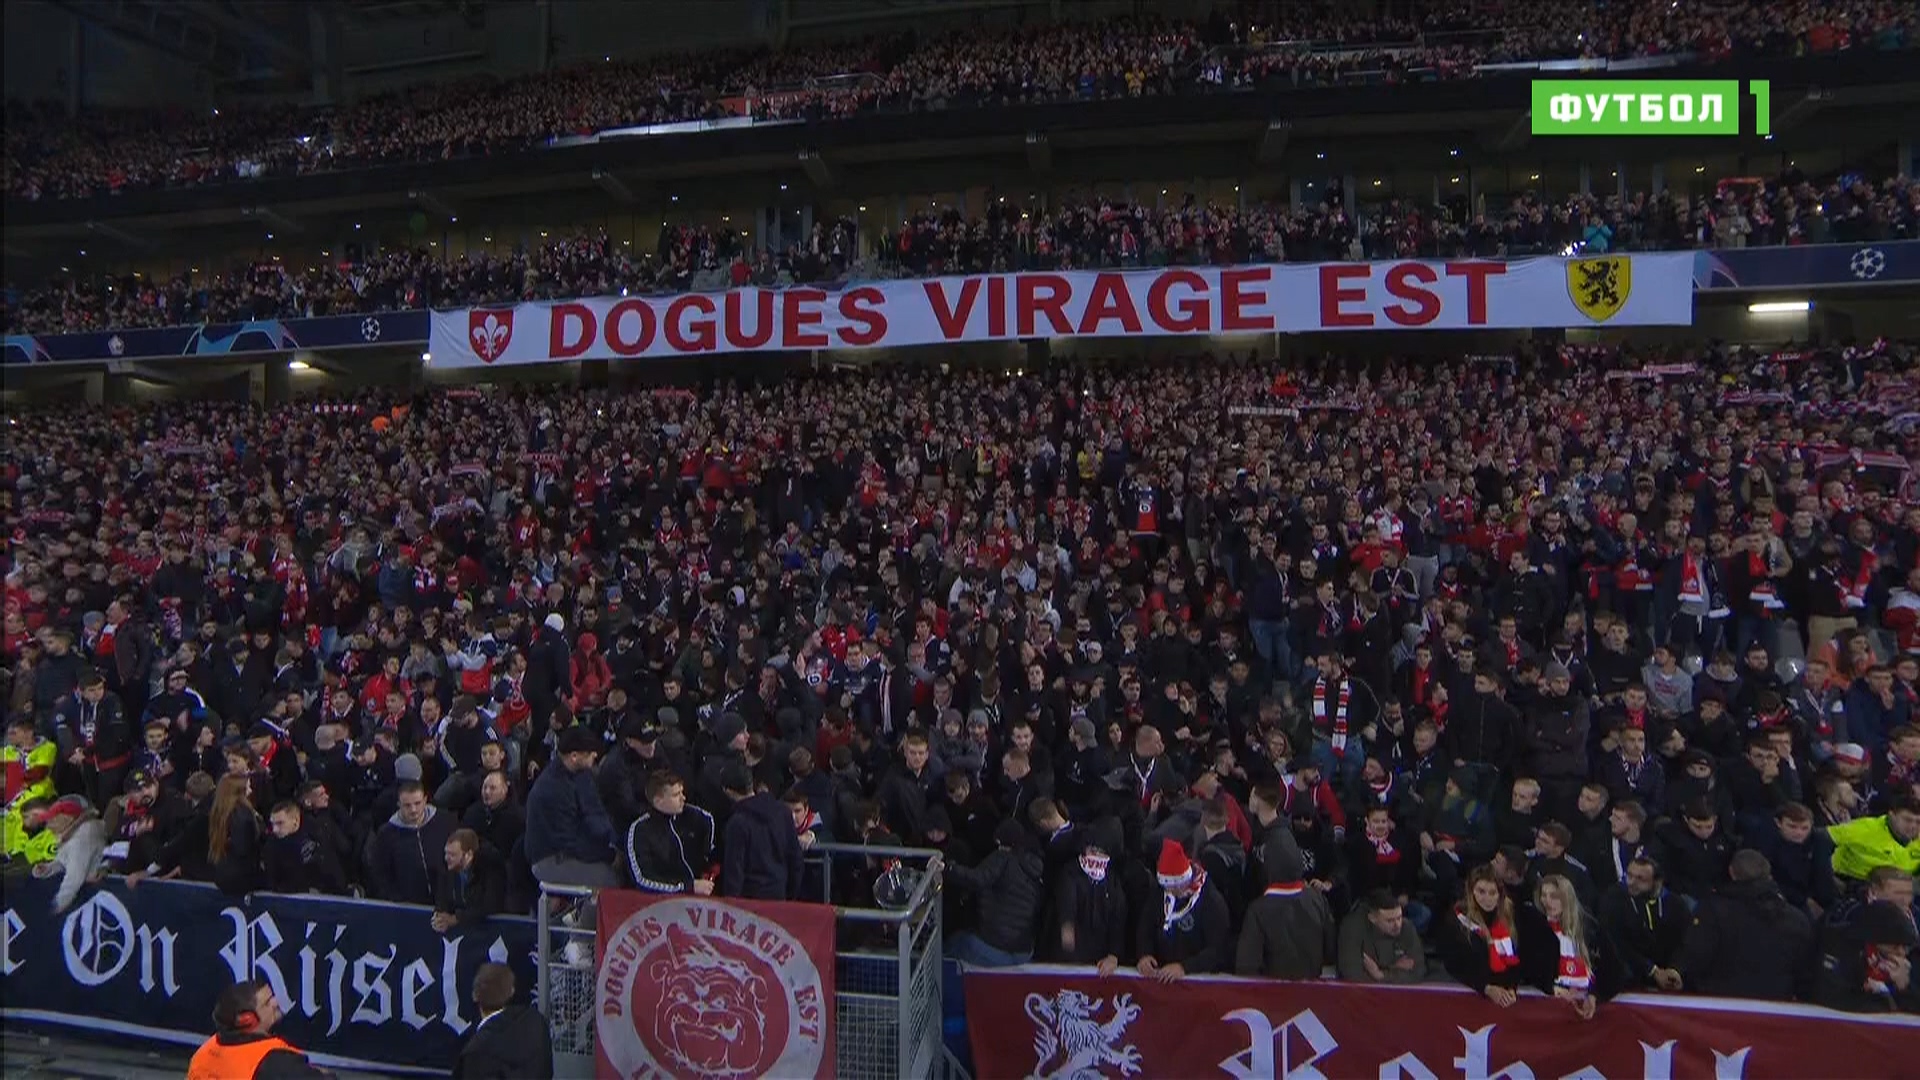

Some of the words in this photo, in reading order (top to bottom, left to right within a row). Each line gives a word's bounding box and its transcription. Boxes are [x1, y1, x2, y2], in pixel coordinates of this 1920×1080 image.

[549, 287, 888, 358] DOGUES
[923, 267, 1275, 339] VIRAGE
[1319, 262, 1506, 327] EST
[62, 889, 180, 997] On
[218, 905, 471, 1037] Rijsel
[604, 916, 664, 1017] DOGUES
[686, 907, 795, 967] VIRAGE
[794, 985, 818, 1043] EST
